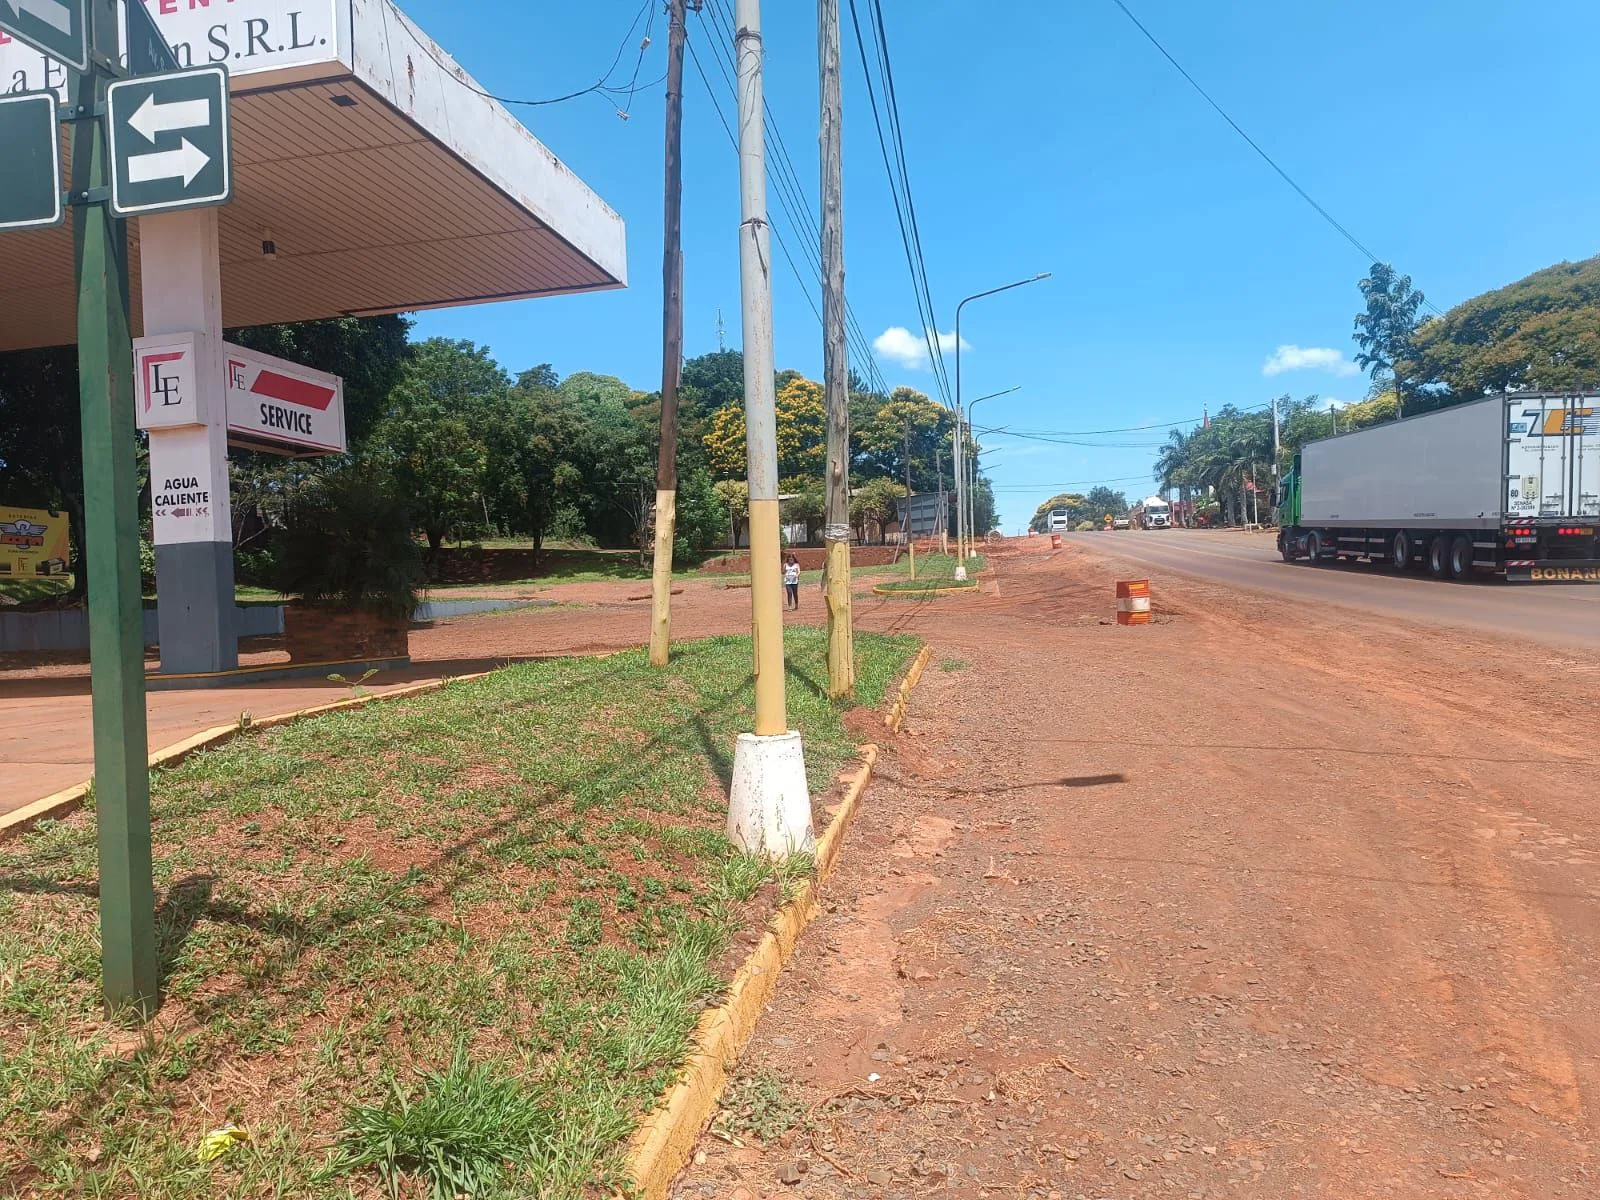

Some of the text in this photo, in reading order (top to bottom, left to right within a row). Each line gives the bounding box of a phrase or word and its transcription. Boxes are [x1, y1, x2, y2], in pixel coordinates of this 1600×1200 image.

[207, 11, 326, 63] S.R.L.
[152, 364, 182, 406] LE
[260, 403, 313, 435] SERVICE
[164, 477, 199, 490] AGUA
[154, 491, 209, 506] CALIENTE
[1531, 568, 1600, 579] BONAN
